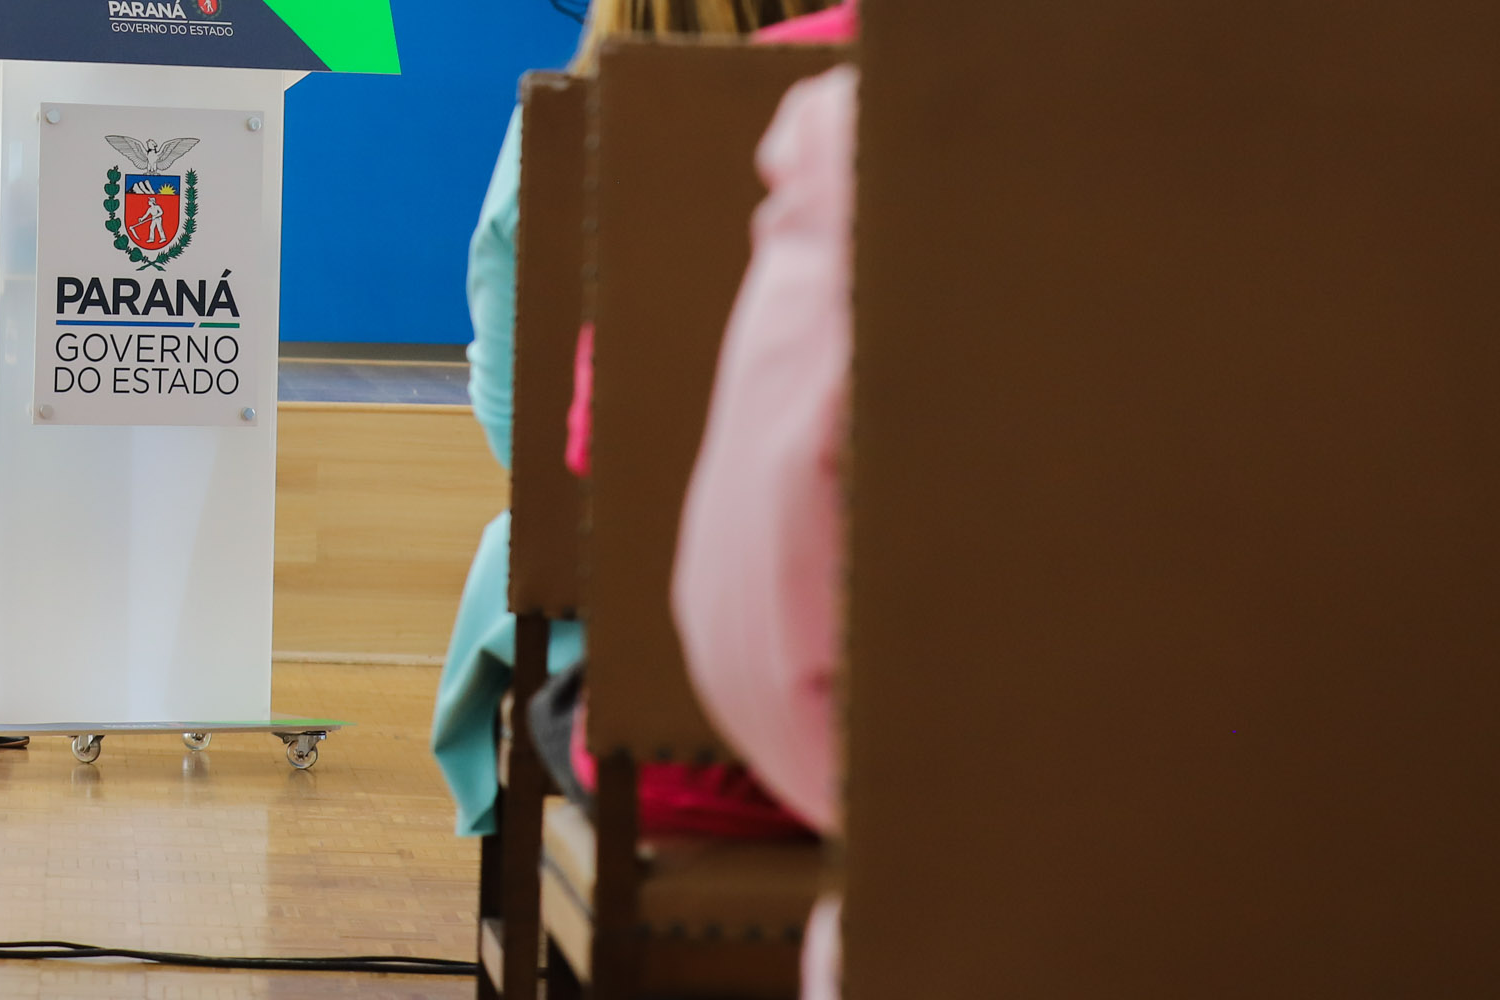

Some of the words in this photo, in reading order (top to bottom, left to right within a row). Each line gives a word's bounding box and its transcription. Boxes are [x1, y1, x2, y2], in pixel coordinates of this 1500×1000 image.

[108, 0, 187, 19] PARANÁ
[111, 22, 168, 34] GOVERNO
[170, 24, 187, 35] DO
[190, 25, 234, 37] ESTADO
[56, 268, 240, 317] PARANÁ
[55, 333, 239, 364] GOVERNO
[54, 366, 101, 393] DO
[113, 367, 239, 395] ESTADO
